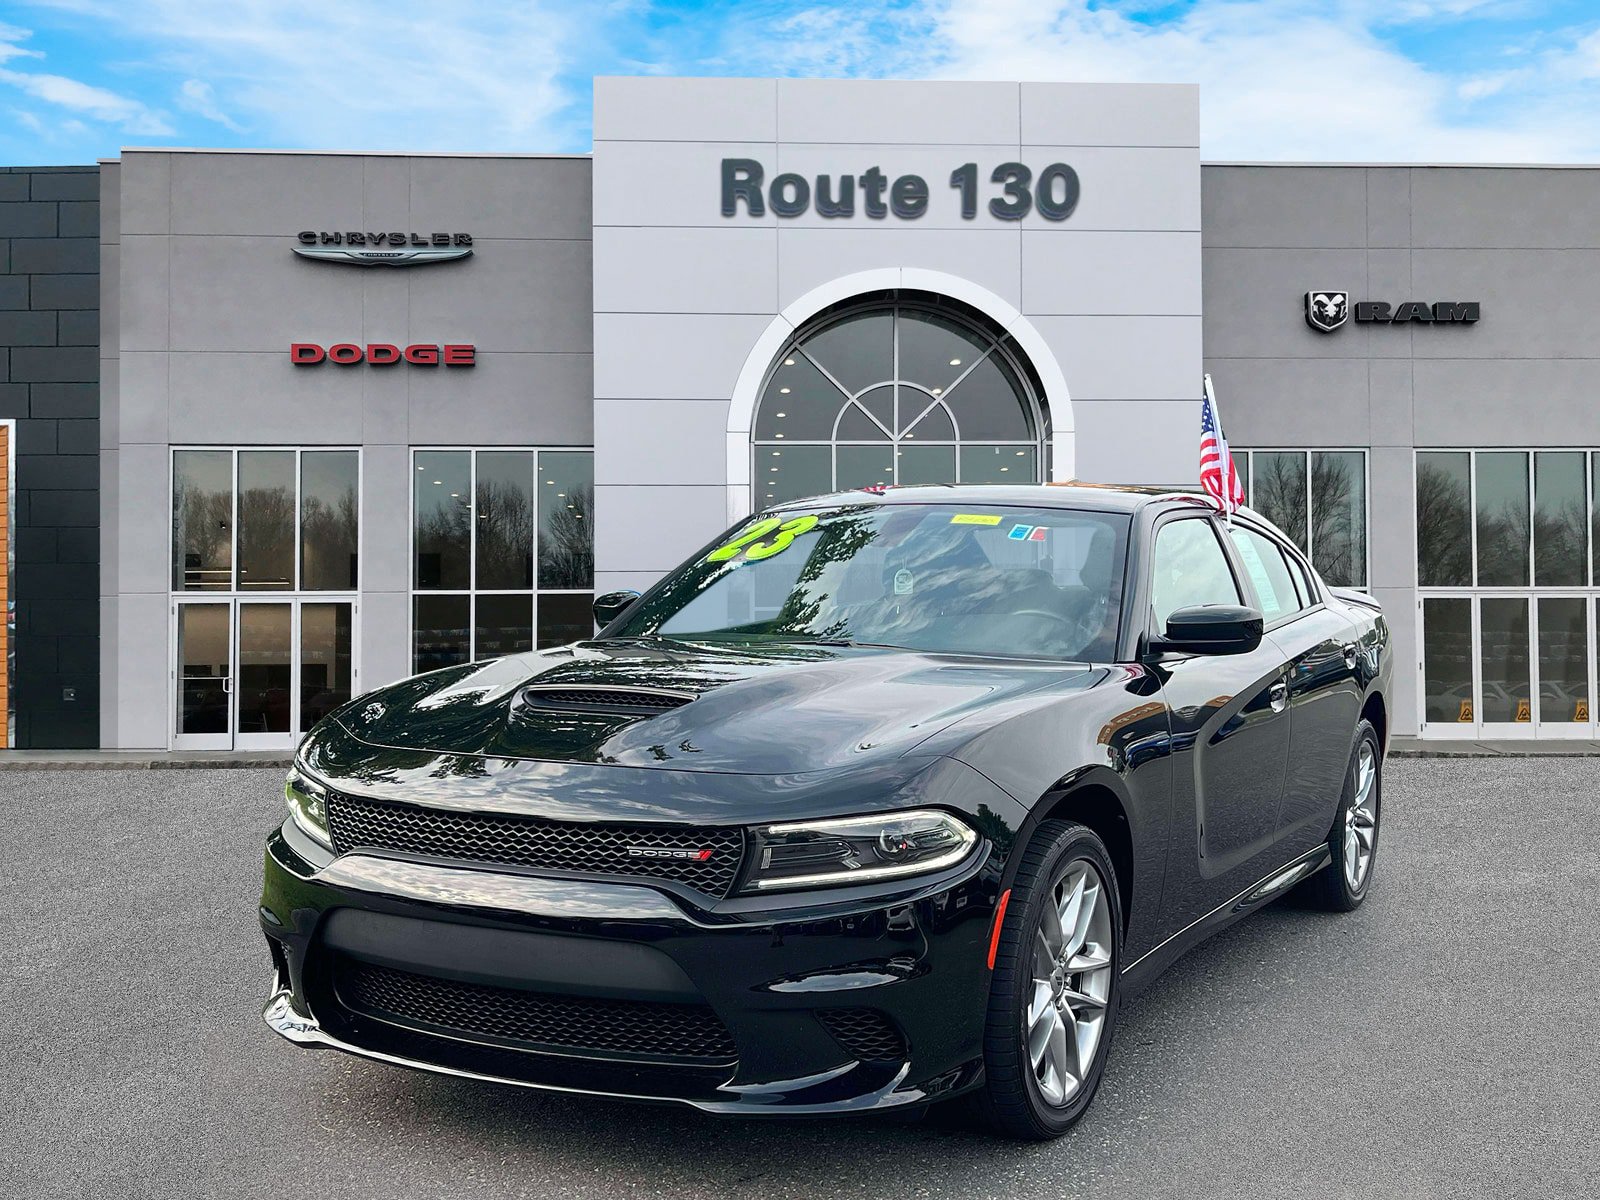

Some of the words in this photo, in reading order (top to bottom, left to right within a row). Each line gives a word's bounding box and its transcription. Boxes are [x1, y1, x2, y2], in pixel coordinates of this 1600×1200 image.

[720, 157, 929, 219] Route
[949, 162, 1081, 221] 130
[297, 230, 474, 246] CHRYSLER
[1354, 301, 1481, 324] RAM
[290, 343, 476, 367] DODGE
[706, 514, 819, 562] 23
[628, 849, 701, 859] DODGE
